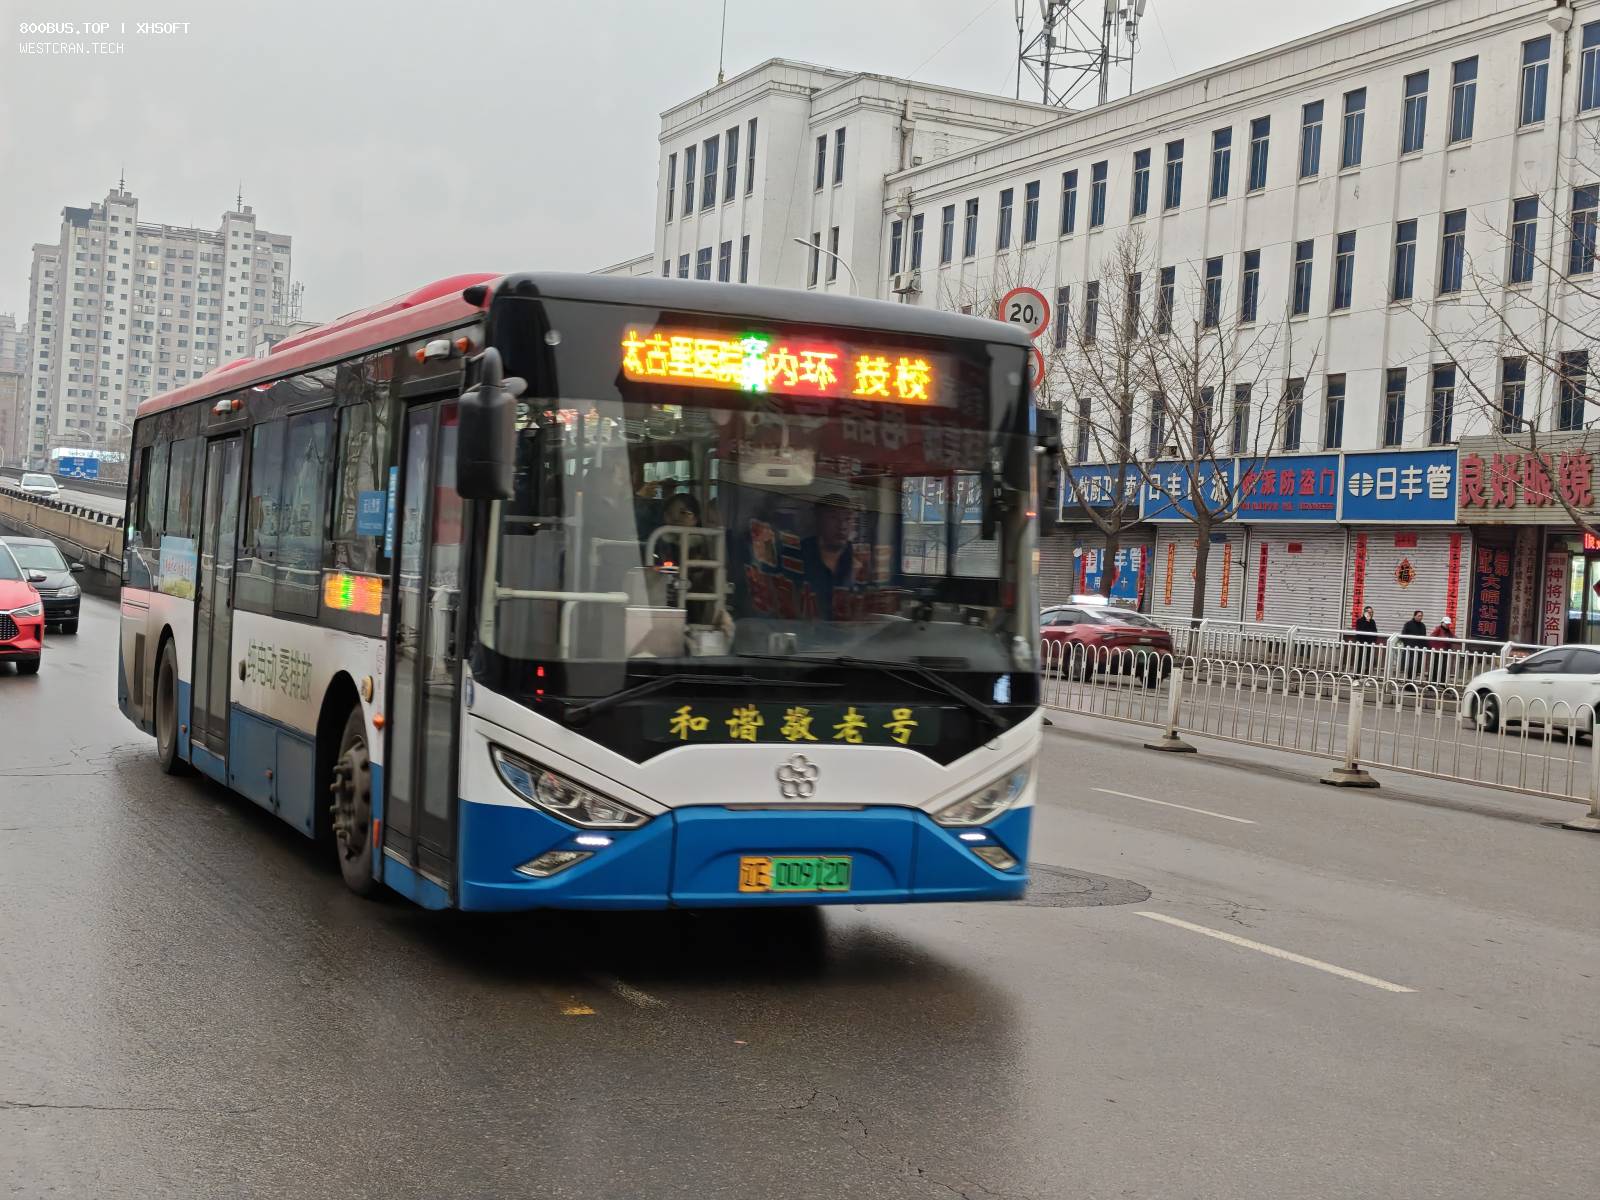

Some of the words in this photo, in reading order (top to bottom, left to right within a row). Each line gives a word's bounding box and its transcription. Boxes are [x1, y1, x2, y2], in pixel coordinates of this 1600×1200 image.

[853, 354, 932, 399] 技校
[1376, 464, 1452, 500] 日丰管
[1460, 448, 1595, 508] 良好眼镜
[1544, 567, 1564, 646] 神将防盗门
[669, 703, 919, 744] 和谐敬老号
